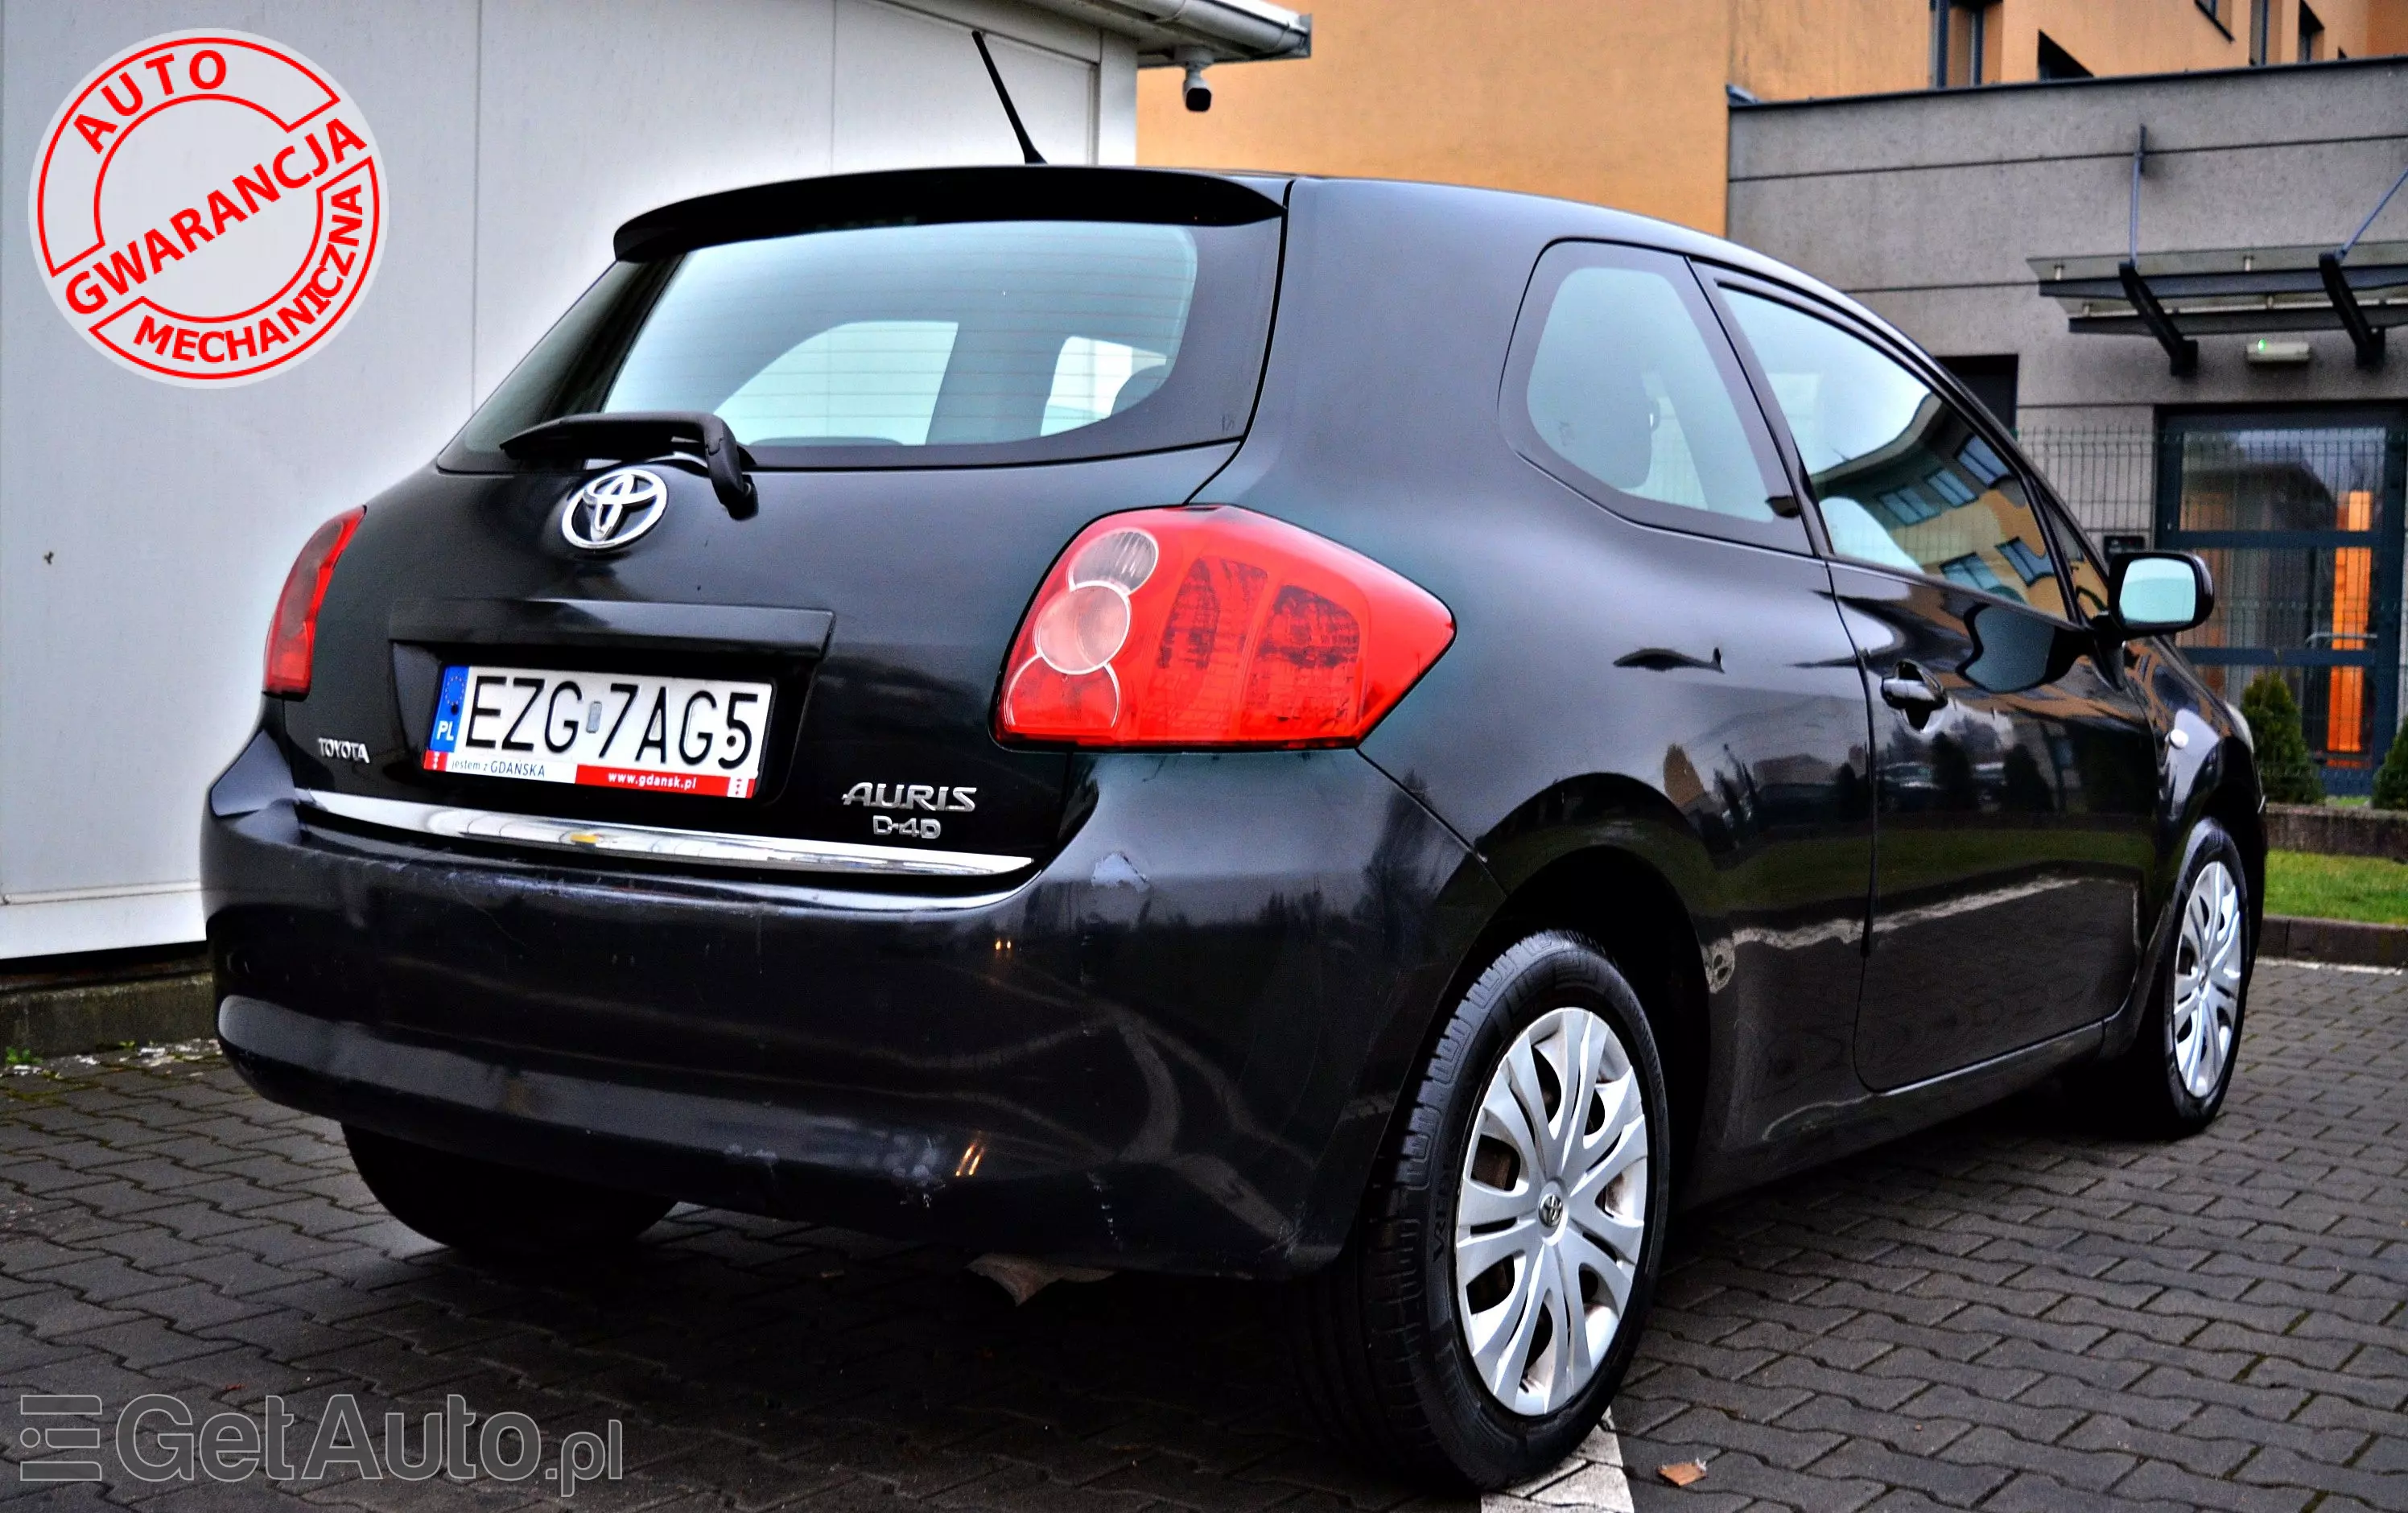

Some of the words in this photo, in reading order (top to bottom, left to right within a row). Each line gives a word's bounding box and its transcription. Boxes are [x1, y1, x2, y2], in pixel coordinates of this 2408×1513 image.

[436, 720, 454, 741] PL
[466, 675, 583, 754] EZG
[599, 682, 758, 769] 7AG5
[318, 737, 370, 764] TOYOTA
[452, 760, 480, 770] jestem
[483, 762, 488, 772] z
[490, 759, 545, 777] GDAŃSKA
[608, 773, 697, 790] www.gdansk.pl
[842, 782, 977, 812] AURIS
[872, 814, 942, 839] D-4D
